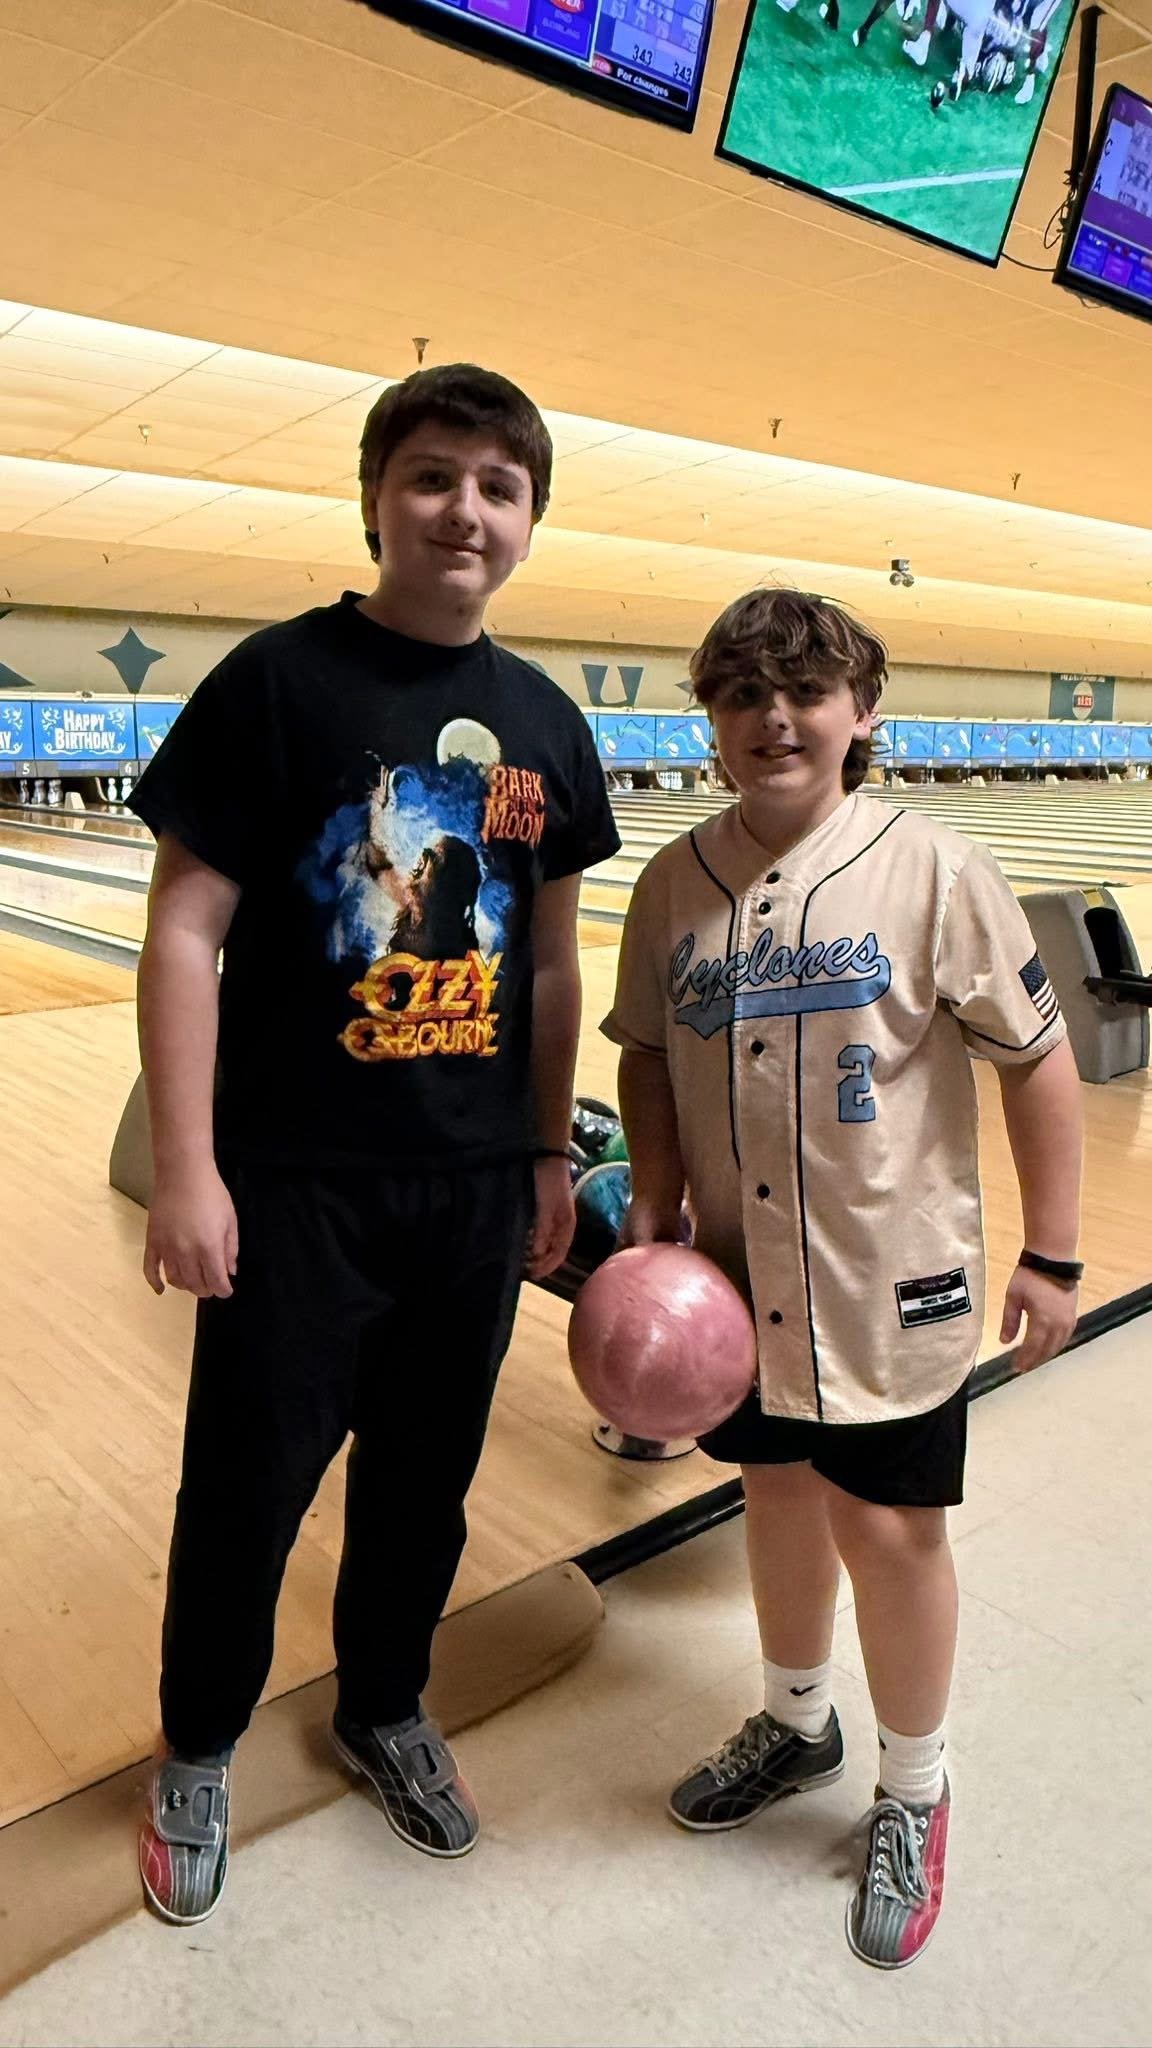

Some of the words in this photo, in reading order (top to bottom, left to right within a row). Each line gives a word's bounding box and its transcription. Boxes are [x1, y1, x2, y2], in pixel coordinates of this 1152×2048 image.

[633, 44, 653, 66] 343
[673, 62, 692, 83] 343
[633, 74, 670, 97] changes
[54, 727, 116, 750] BIRTHDAY
[63, 709, 105, 732] HAPPY
[22, 763, 30, 775] 5
[125, 762, 132, 774] 6
[490, 765, 545, 804] BARK
[481, 797, 545, 848] MOON
[349, 950, 504, 1022] OZZY
[668, 927, 891, 1013] Cyclones
[336, 1013, 500, 1063] OSBOURNE
[837, 1044, 877, 1123] 2
